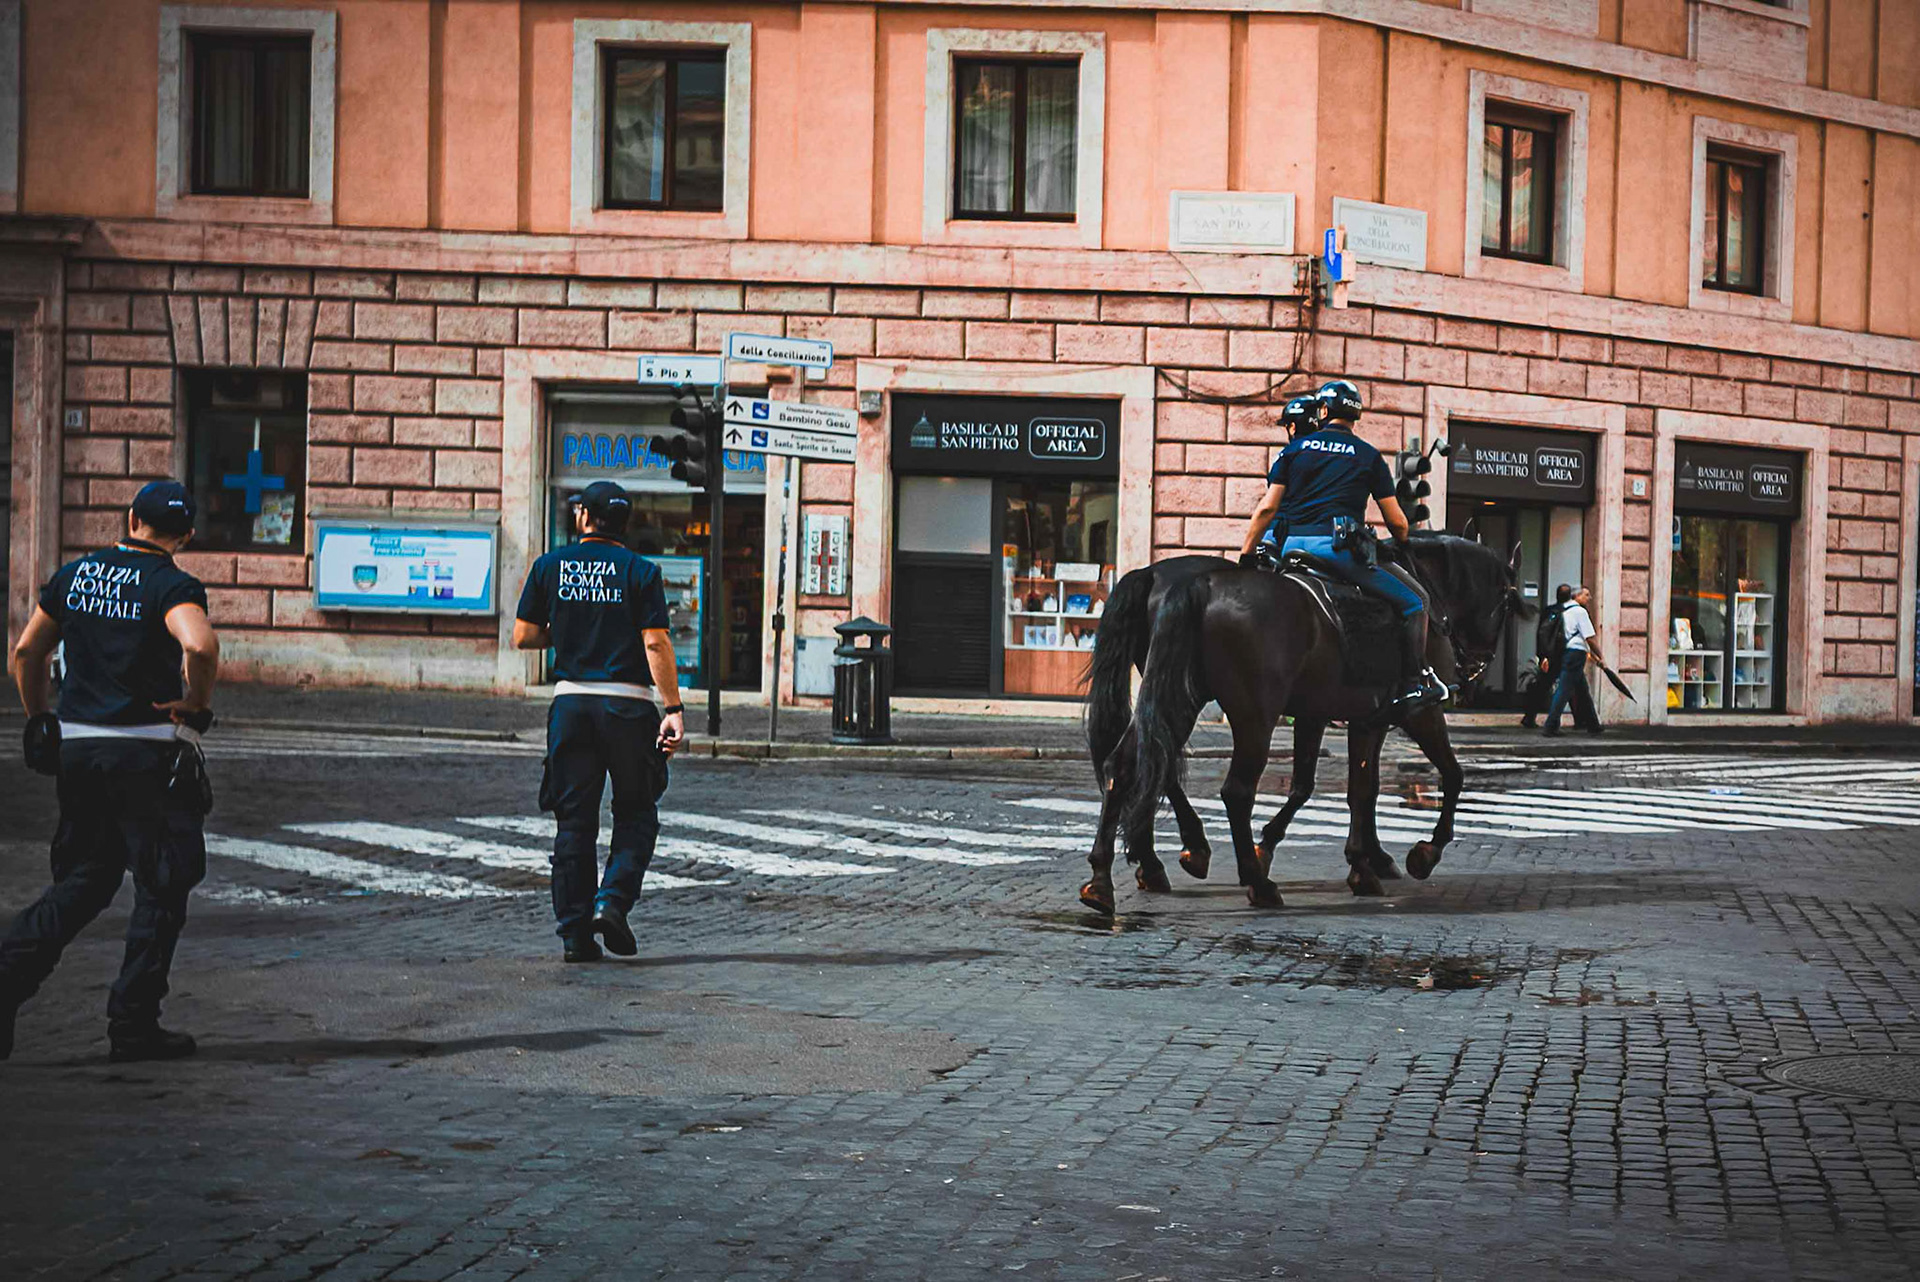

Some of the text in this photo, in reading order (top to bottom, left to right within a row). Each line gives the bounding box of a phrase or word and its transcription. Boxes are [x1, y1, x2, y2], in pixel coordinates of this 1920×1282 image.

[1373, 216, 1389, 227] VIA
[740, 345, 763, 357] della
[767, 347, 827, 363] Conciliazione
[661, 368, 679, 379] Pio
[685, 369, 693, 379] X
[780, 412, 851, 429] Bambino Gesù
[942, 422, 1019, 436] BASILICA DI
[1035, 424, 1099, 439] OFFICIAL
[941, 436, 1020, 451] SAN PIETRO
[1047, 440, 1087, 452] AREA
[1302, 440, 1356, 455] POLIZIA
[1476, 449, 1529, 464] BASILICA DI
[1539, 454, 1580, 468] OFFICIAL
[1475, 462, 1529, 477] SAN PIETRO
[1547, 469, 1573, 481] AREA
[1698, 466, 1735, 480] BASILICA
[1753, 471, 1789, 484] OFFICIAL
[1697, 479, 1744, 493] SAN PIETRO
[1760, 485, 1783, 496] AREA
[76, 561, 140, 586] POLIZIA
[560, 560, 617, 576] POLIZIA
[70, 576, 121, 600] ROMA
[559, 574, 604, 588] ROMA
[558, 587, 622, 603] CAPITALE
[66, 592, 142, 621] CAPITALE
